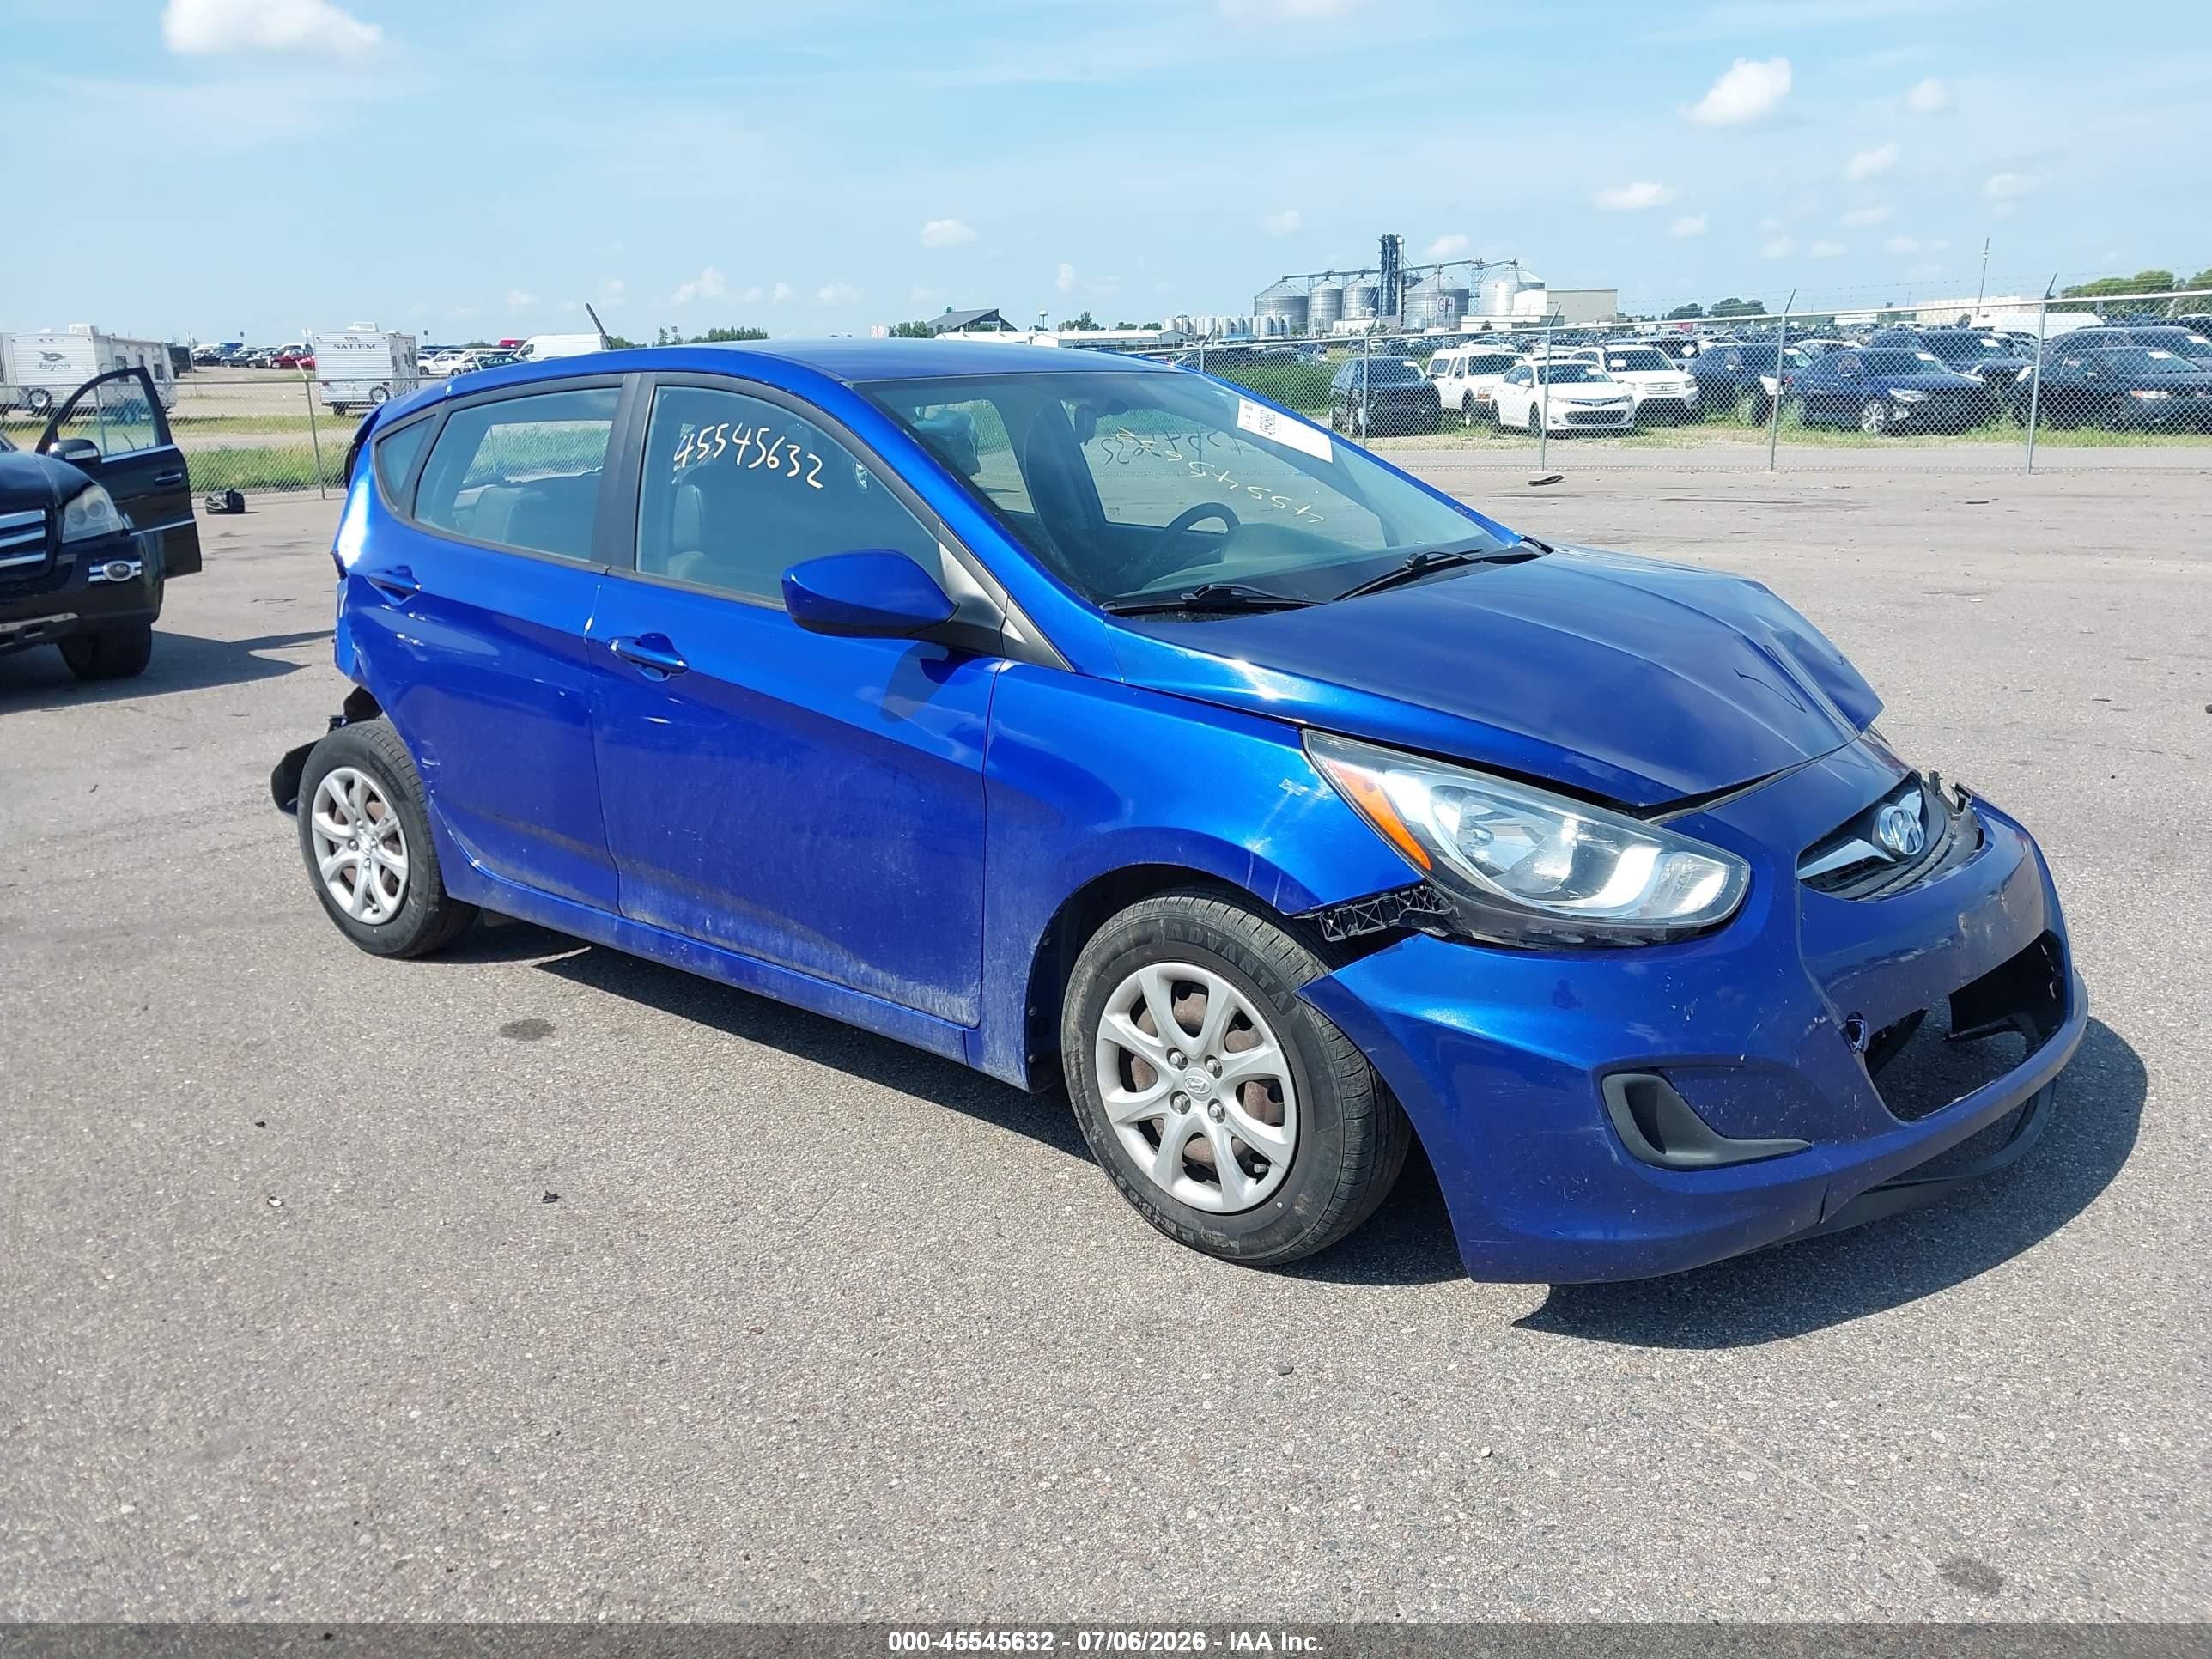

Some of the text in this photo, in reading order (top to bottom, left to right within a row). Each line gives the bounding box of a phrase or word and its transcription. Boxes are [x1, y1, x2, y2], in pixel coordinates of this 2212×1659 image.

[1437, 297, 1454, 313] GH
[673, 422, 824, 489] 45545632
[1167, 923, 1288, 1014] ADVANTA
